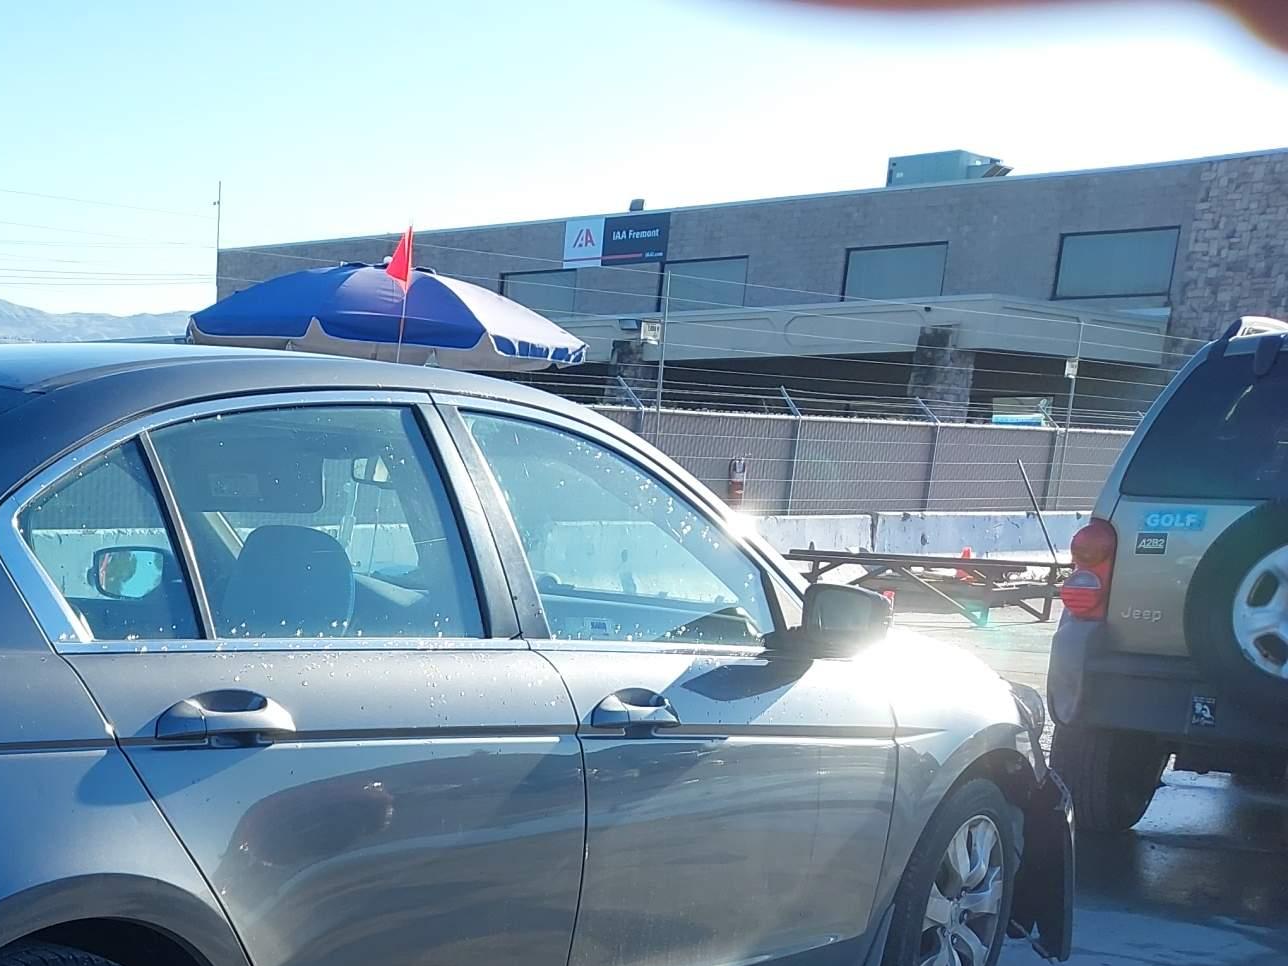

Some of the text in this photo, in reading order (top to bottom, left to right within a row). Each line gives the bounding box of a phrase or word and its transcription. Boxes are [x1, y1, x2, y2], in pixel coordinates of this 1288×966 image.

[613, 229, 660, 240] IAA Fremont
[1146, 513, 1199, 527] GOLF
[1137, 538, 1165, 549] A2B2
[1121, 606, 1162, 622] Jeep
